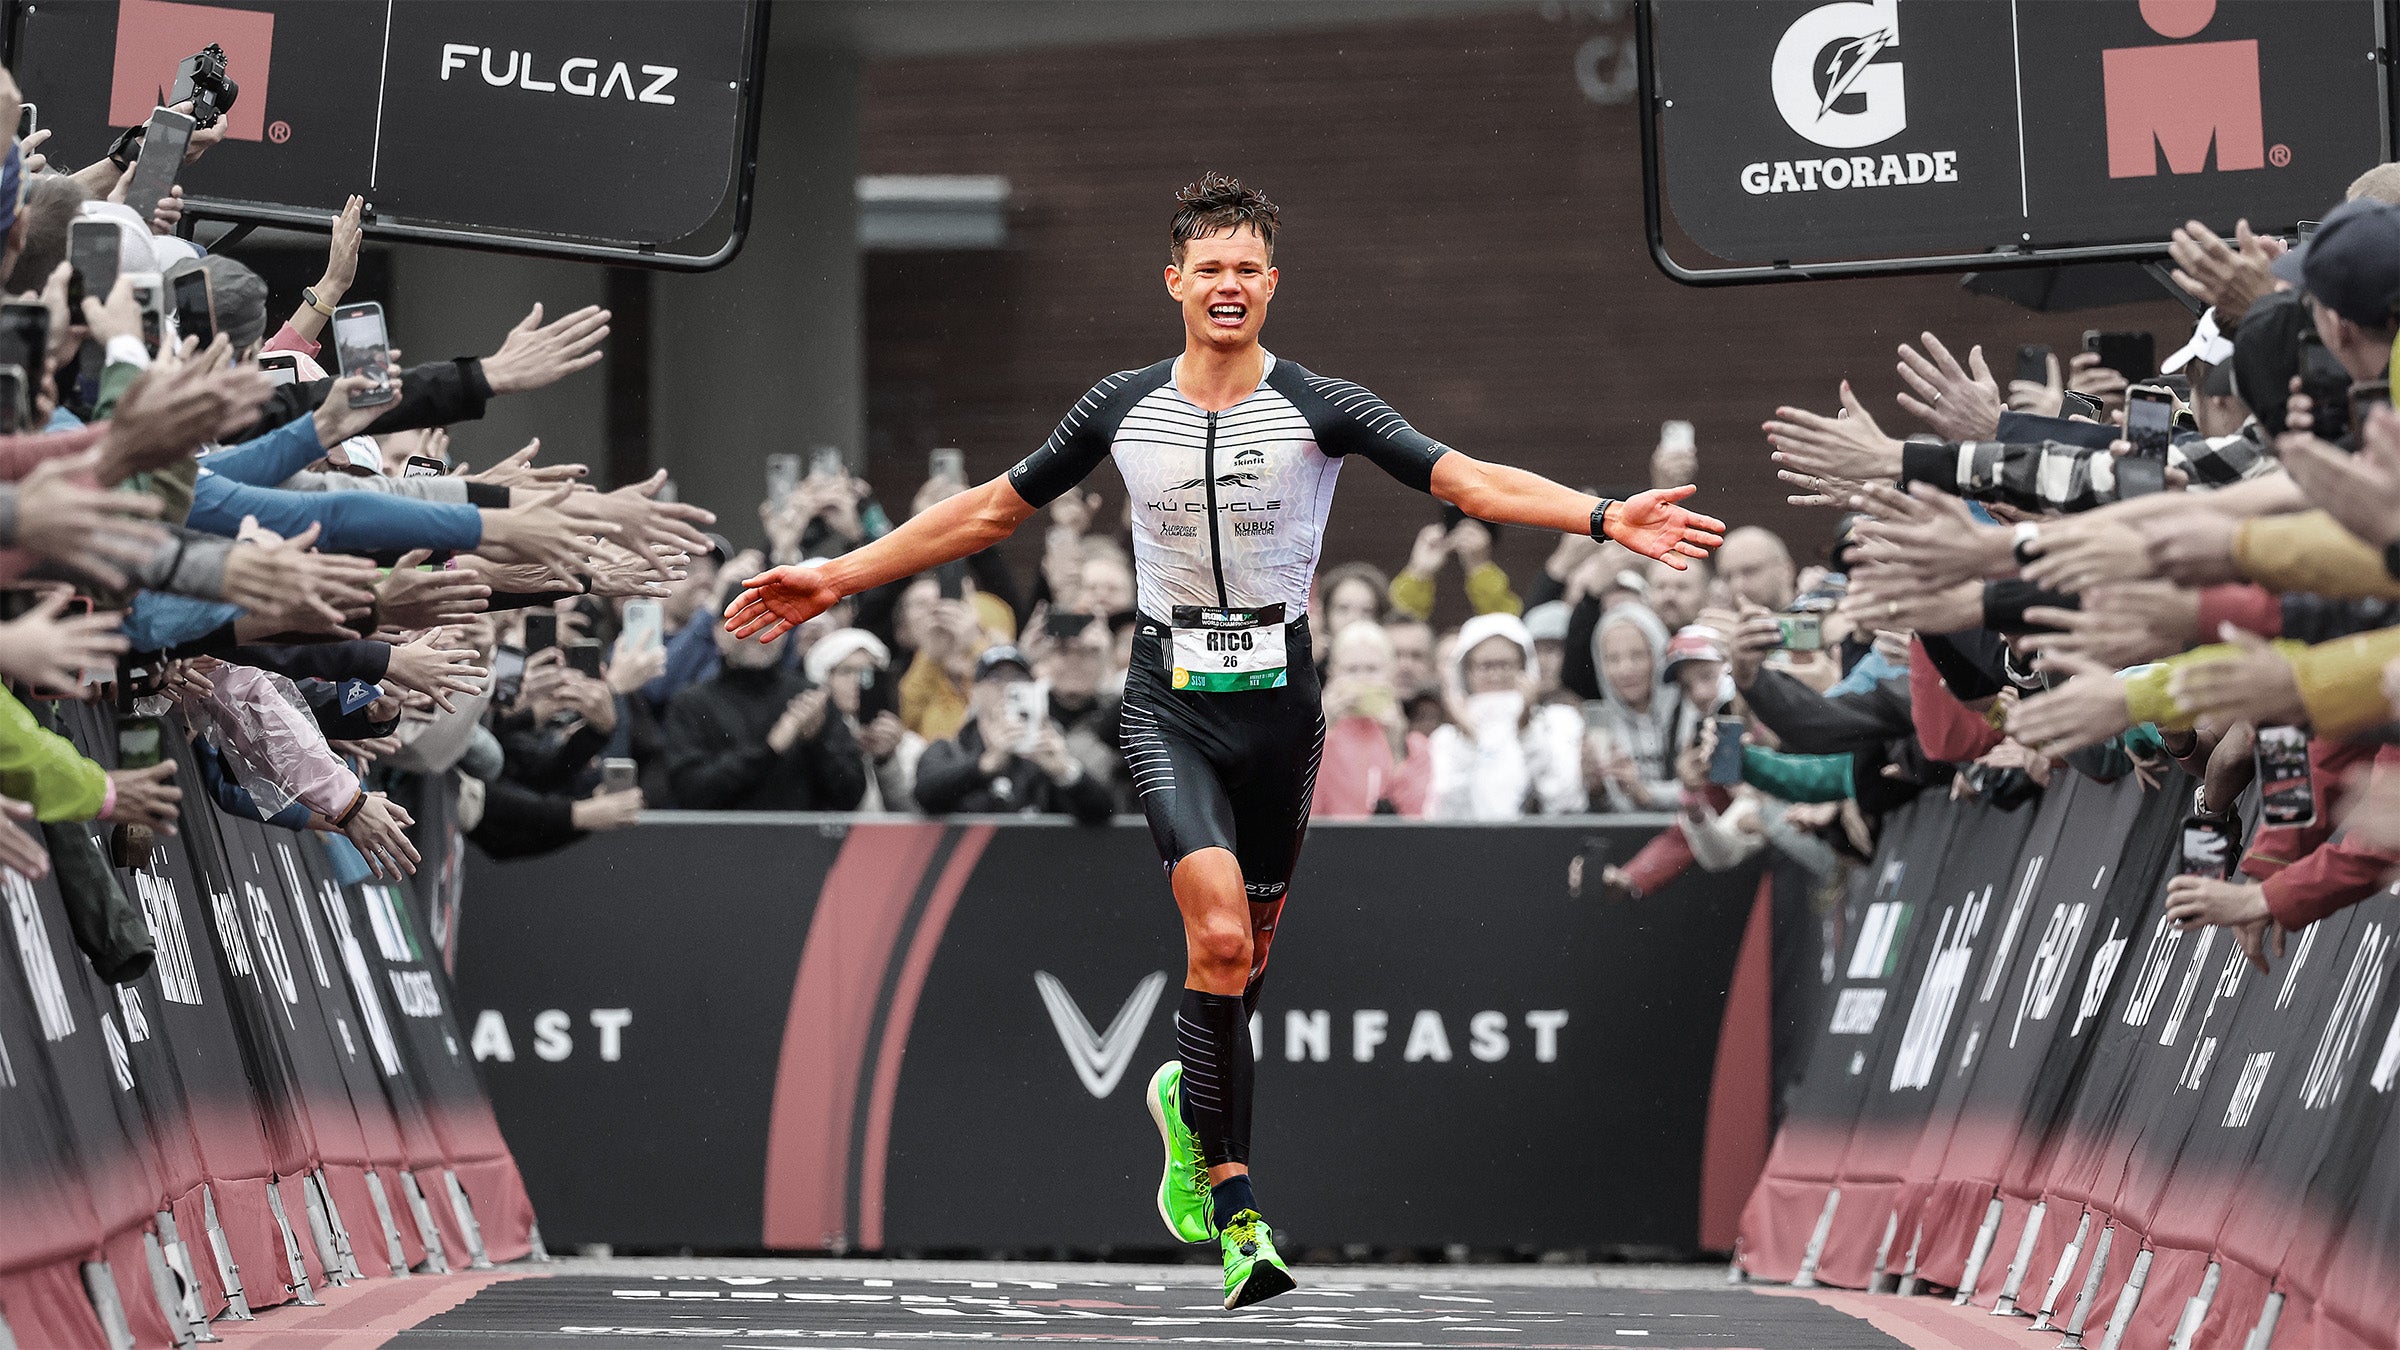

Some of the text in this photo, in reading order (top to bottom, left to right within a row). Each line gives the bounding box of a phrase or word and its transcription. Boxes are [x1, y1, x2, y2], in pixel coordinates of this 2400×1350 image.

[441, 43, 678, 105] FULGAZ
[1771, 0, 1907, 149] G
[1740, 150, 1958, 195] GATORADE
[1234, 457, 1265, 467] skinfit
[1234, 520, 1275, 532] KUBUS
[1206, 631, 1254, 652] RICO
[1223, 656, 1238, 668] 26
